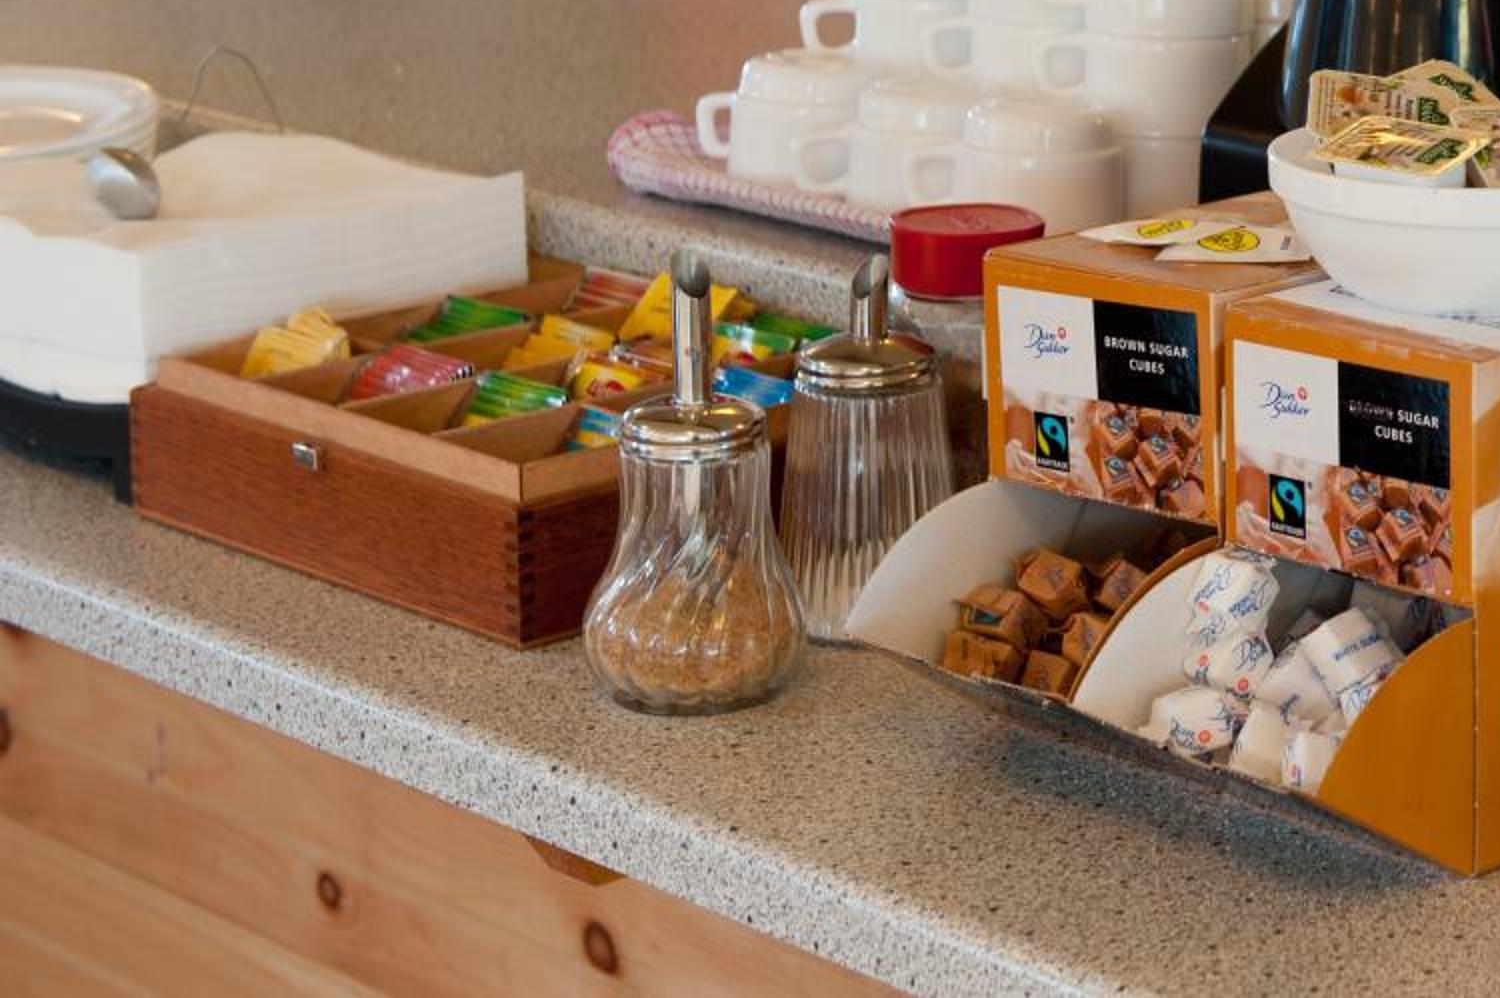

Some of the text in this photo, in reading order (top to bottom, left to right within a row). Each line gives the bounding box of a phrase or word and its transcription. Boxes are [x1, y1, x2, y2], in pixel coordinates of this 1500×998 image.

[1103, 335, 1189, 358] BROWN SUGAR
[1129, 358, 1166, 376] CUBES
[1397, 409, 1440, 429] SUGAR
[1374, 425, 1413, 445] CUBES
